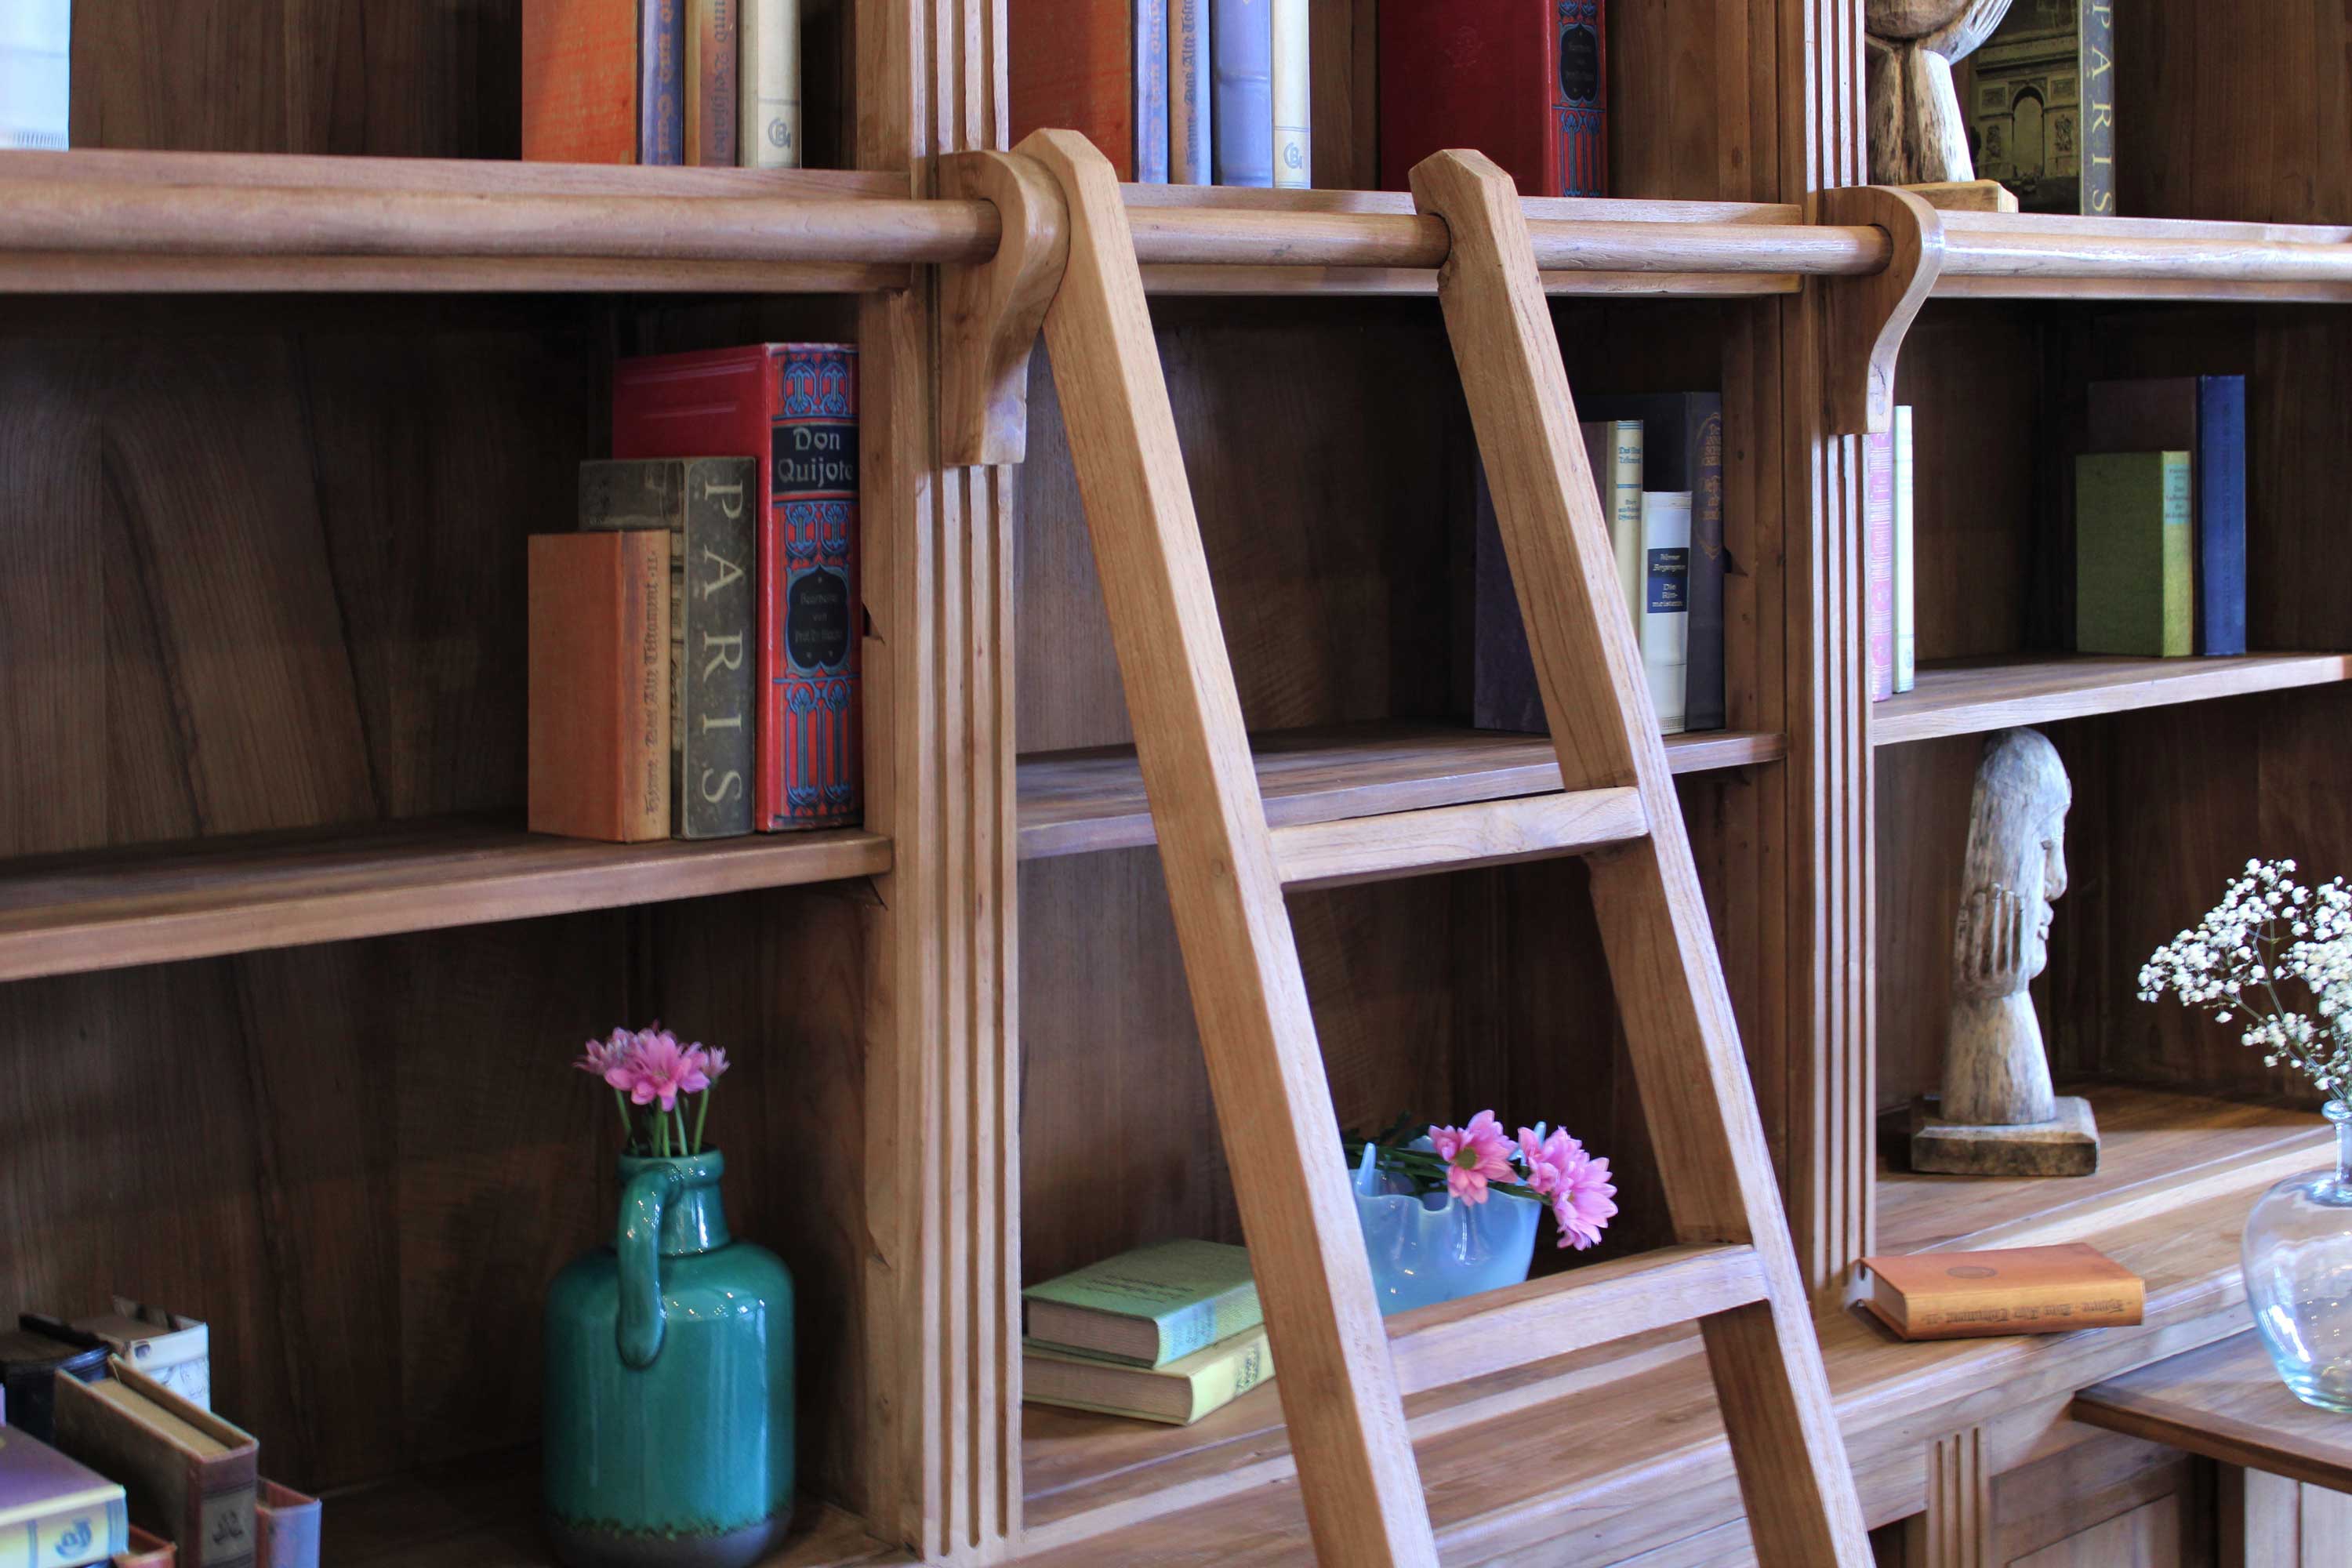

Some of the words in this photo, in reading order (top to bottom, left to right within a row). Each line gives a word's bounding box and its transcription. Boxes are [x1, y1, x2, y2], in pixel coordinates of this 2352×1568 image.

[1181, 36, 1196, 68] Alte
[2092, 2, 2114, 214] PARIS
[793, 426, 840, 451] Don
[777, 456, 854, 488] Quijote
[702, 480, 745, 804] PARIS
